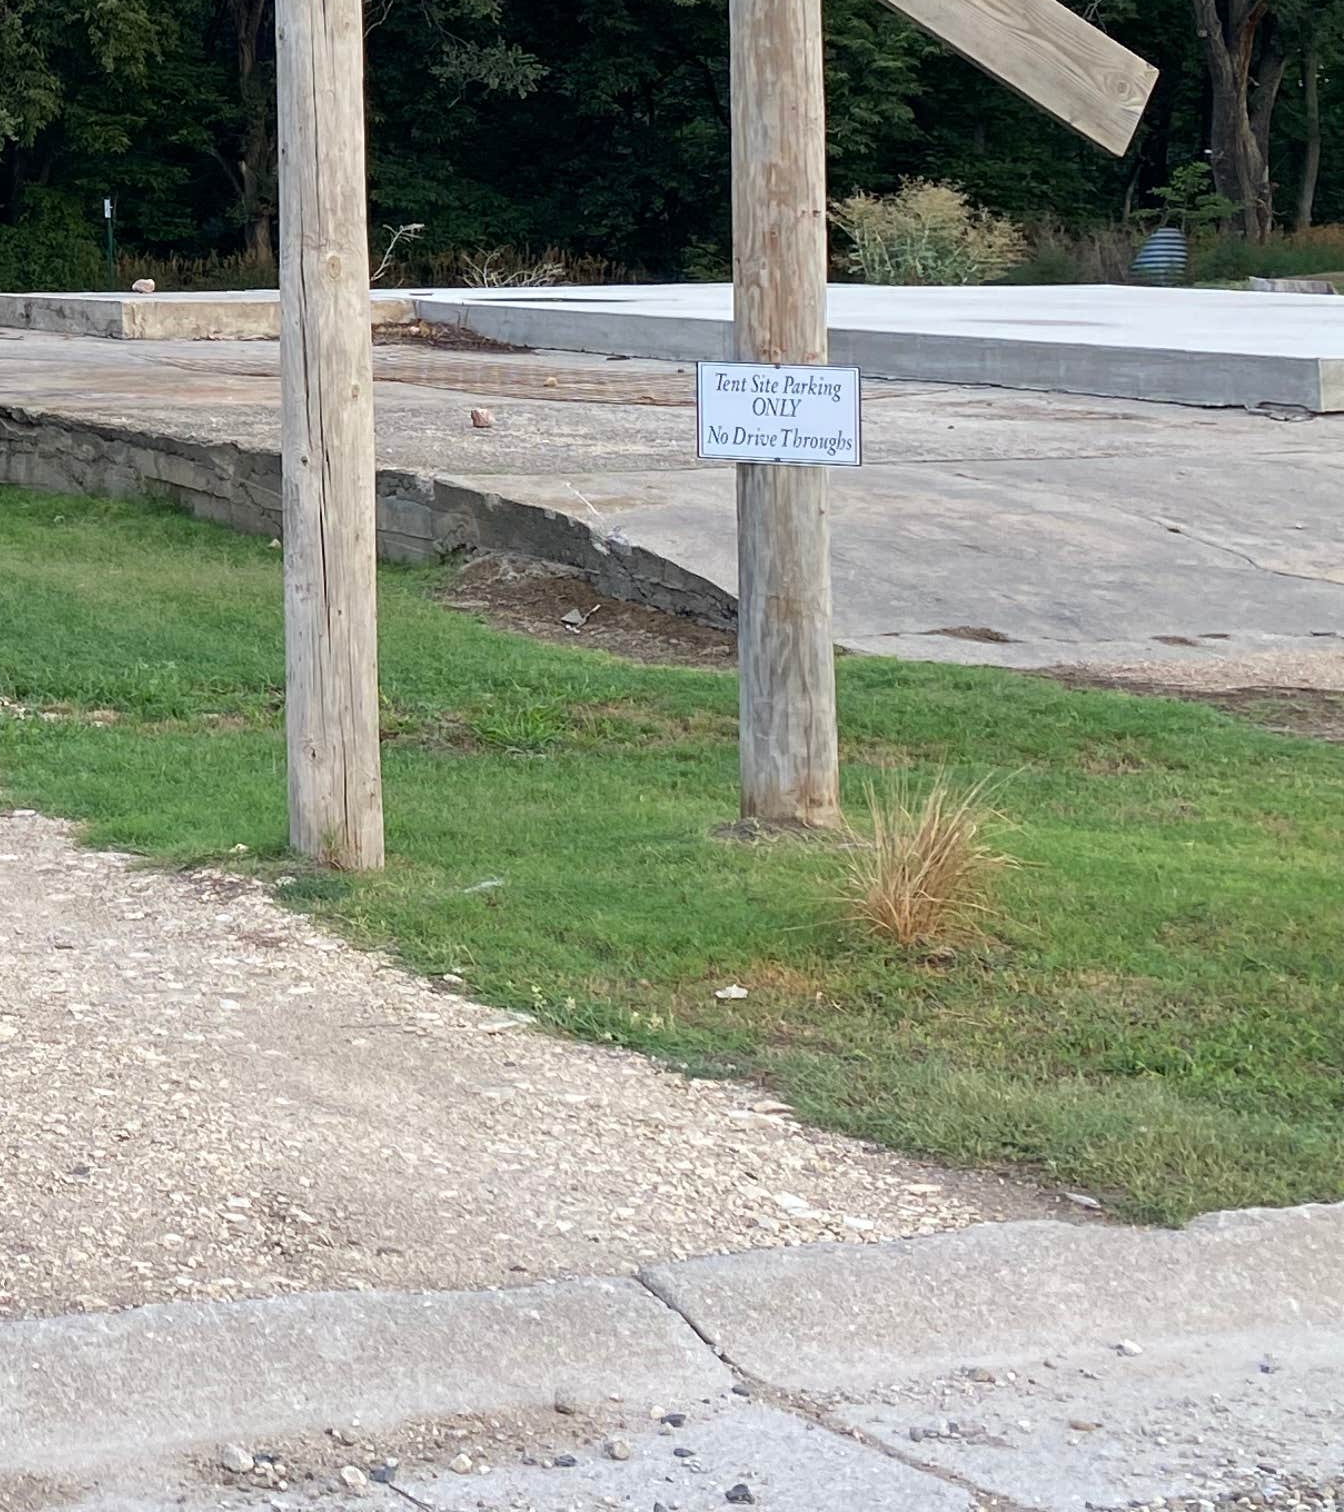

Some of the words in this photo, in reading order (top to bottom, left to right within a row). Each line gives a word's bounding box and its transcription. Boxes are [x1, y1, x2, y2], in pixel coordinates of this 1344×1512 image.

[715, 372, 748, 393] Tent
[751, 373, 779, 395] Site
[782, 375, 842, 402] Parking
[752, 396, 802, 418] ONLY
[707, 425, 729, 445] No
[732, 426, 778, 448] Drive
[780, 428, 853, 456] Throughs
